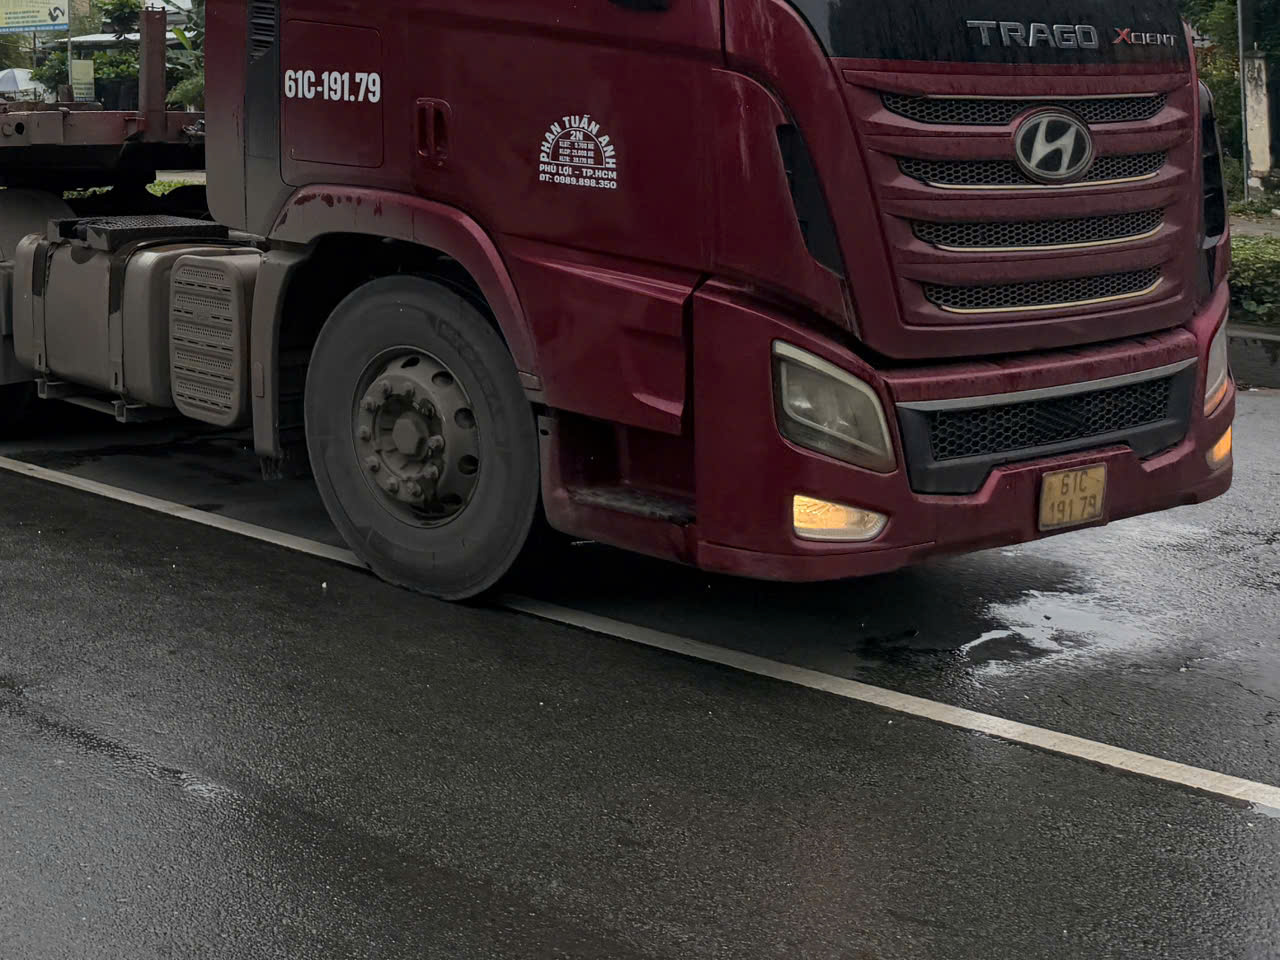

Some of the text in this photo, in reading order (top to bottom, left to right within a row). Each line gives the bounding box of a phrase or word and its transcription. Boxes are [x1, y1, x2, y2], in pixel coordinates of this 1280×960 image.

[966, 20, 1099, 49] TRAGO
[284, 69, 381, 103] 61C-191.79
[540, 122, 562, 161] PHAN
[598, 135, 616, 168] ANH
[570, 130, 584, 141] 2N
[554, 175, 617, 189] 0989.898.350
[581, 168, 617, 179] TP.HCM
[1061, 471, 1088, 496] 61C
